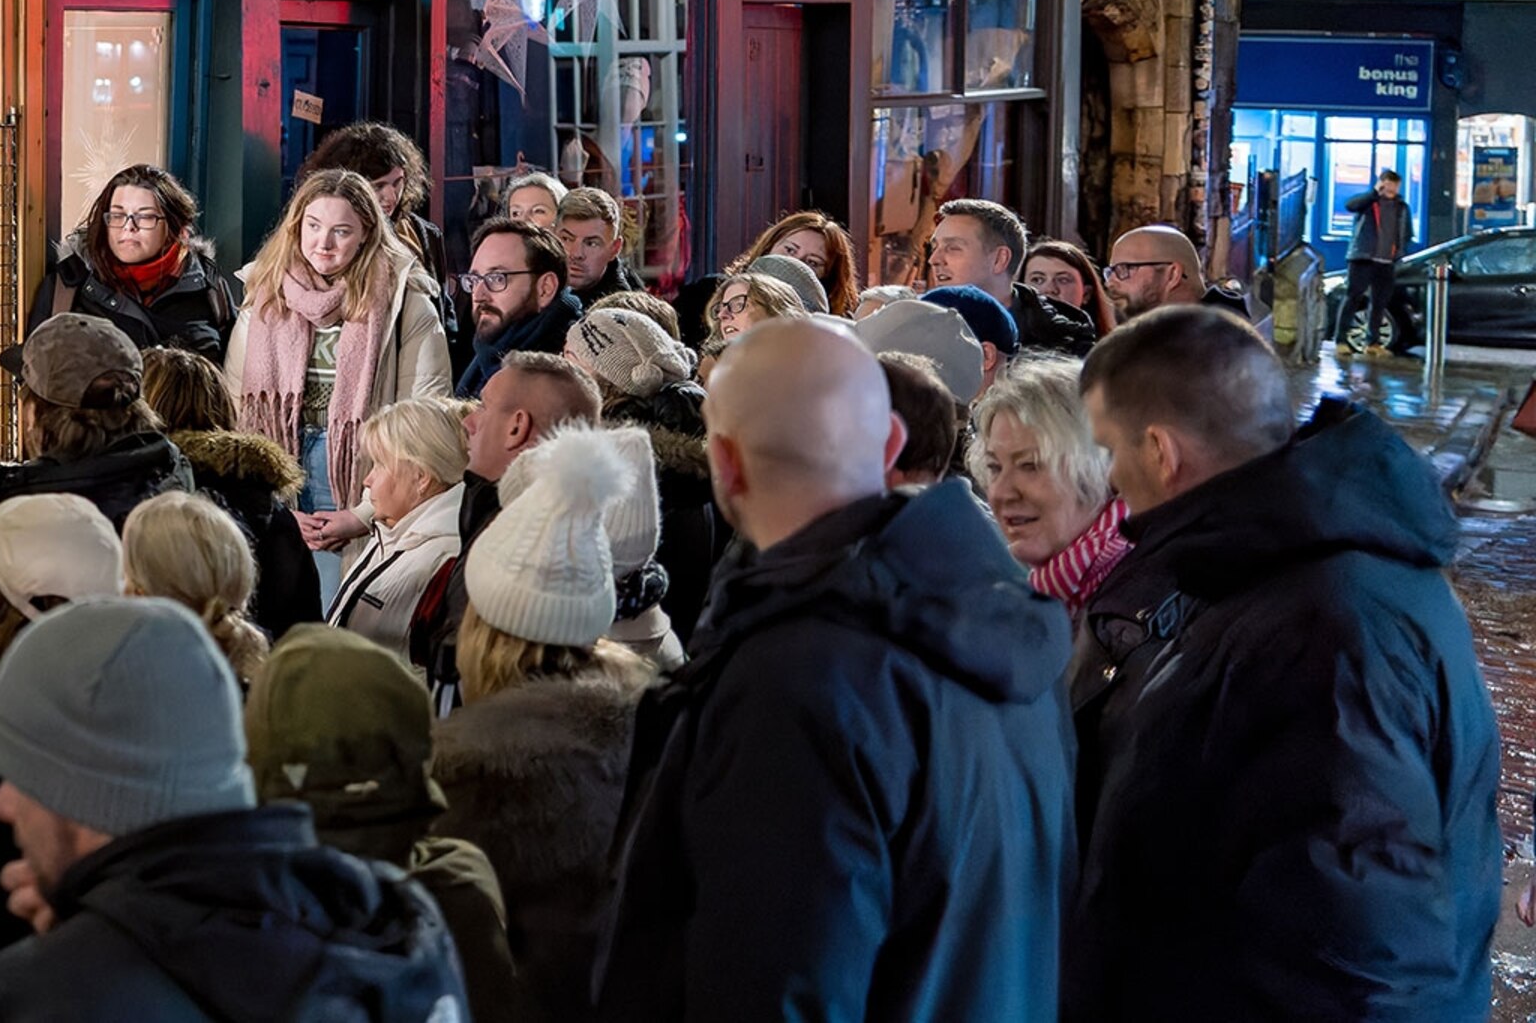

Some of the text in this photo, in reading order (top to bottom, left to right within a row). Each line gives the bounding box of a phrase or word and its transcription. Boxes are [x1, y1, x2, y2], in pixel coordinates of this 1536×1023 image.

[1394, 52, 1419, 67] the
[1358, 66, 1419, 82] bonus
[1375, 82, 1418, 99] king
